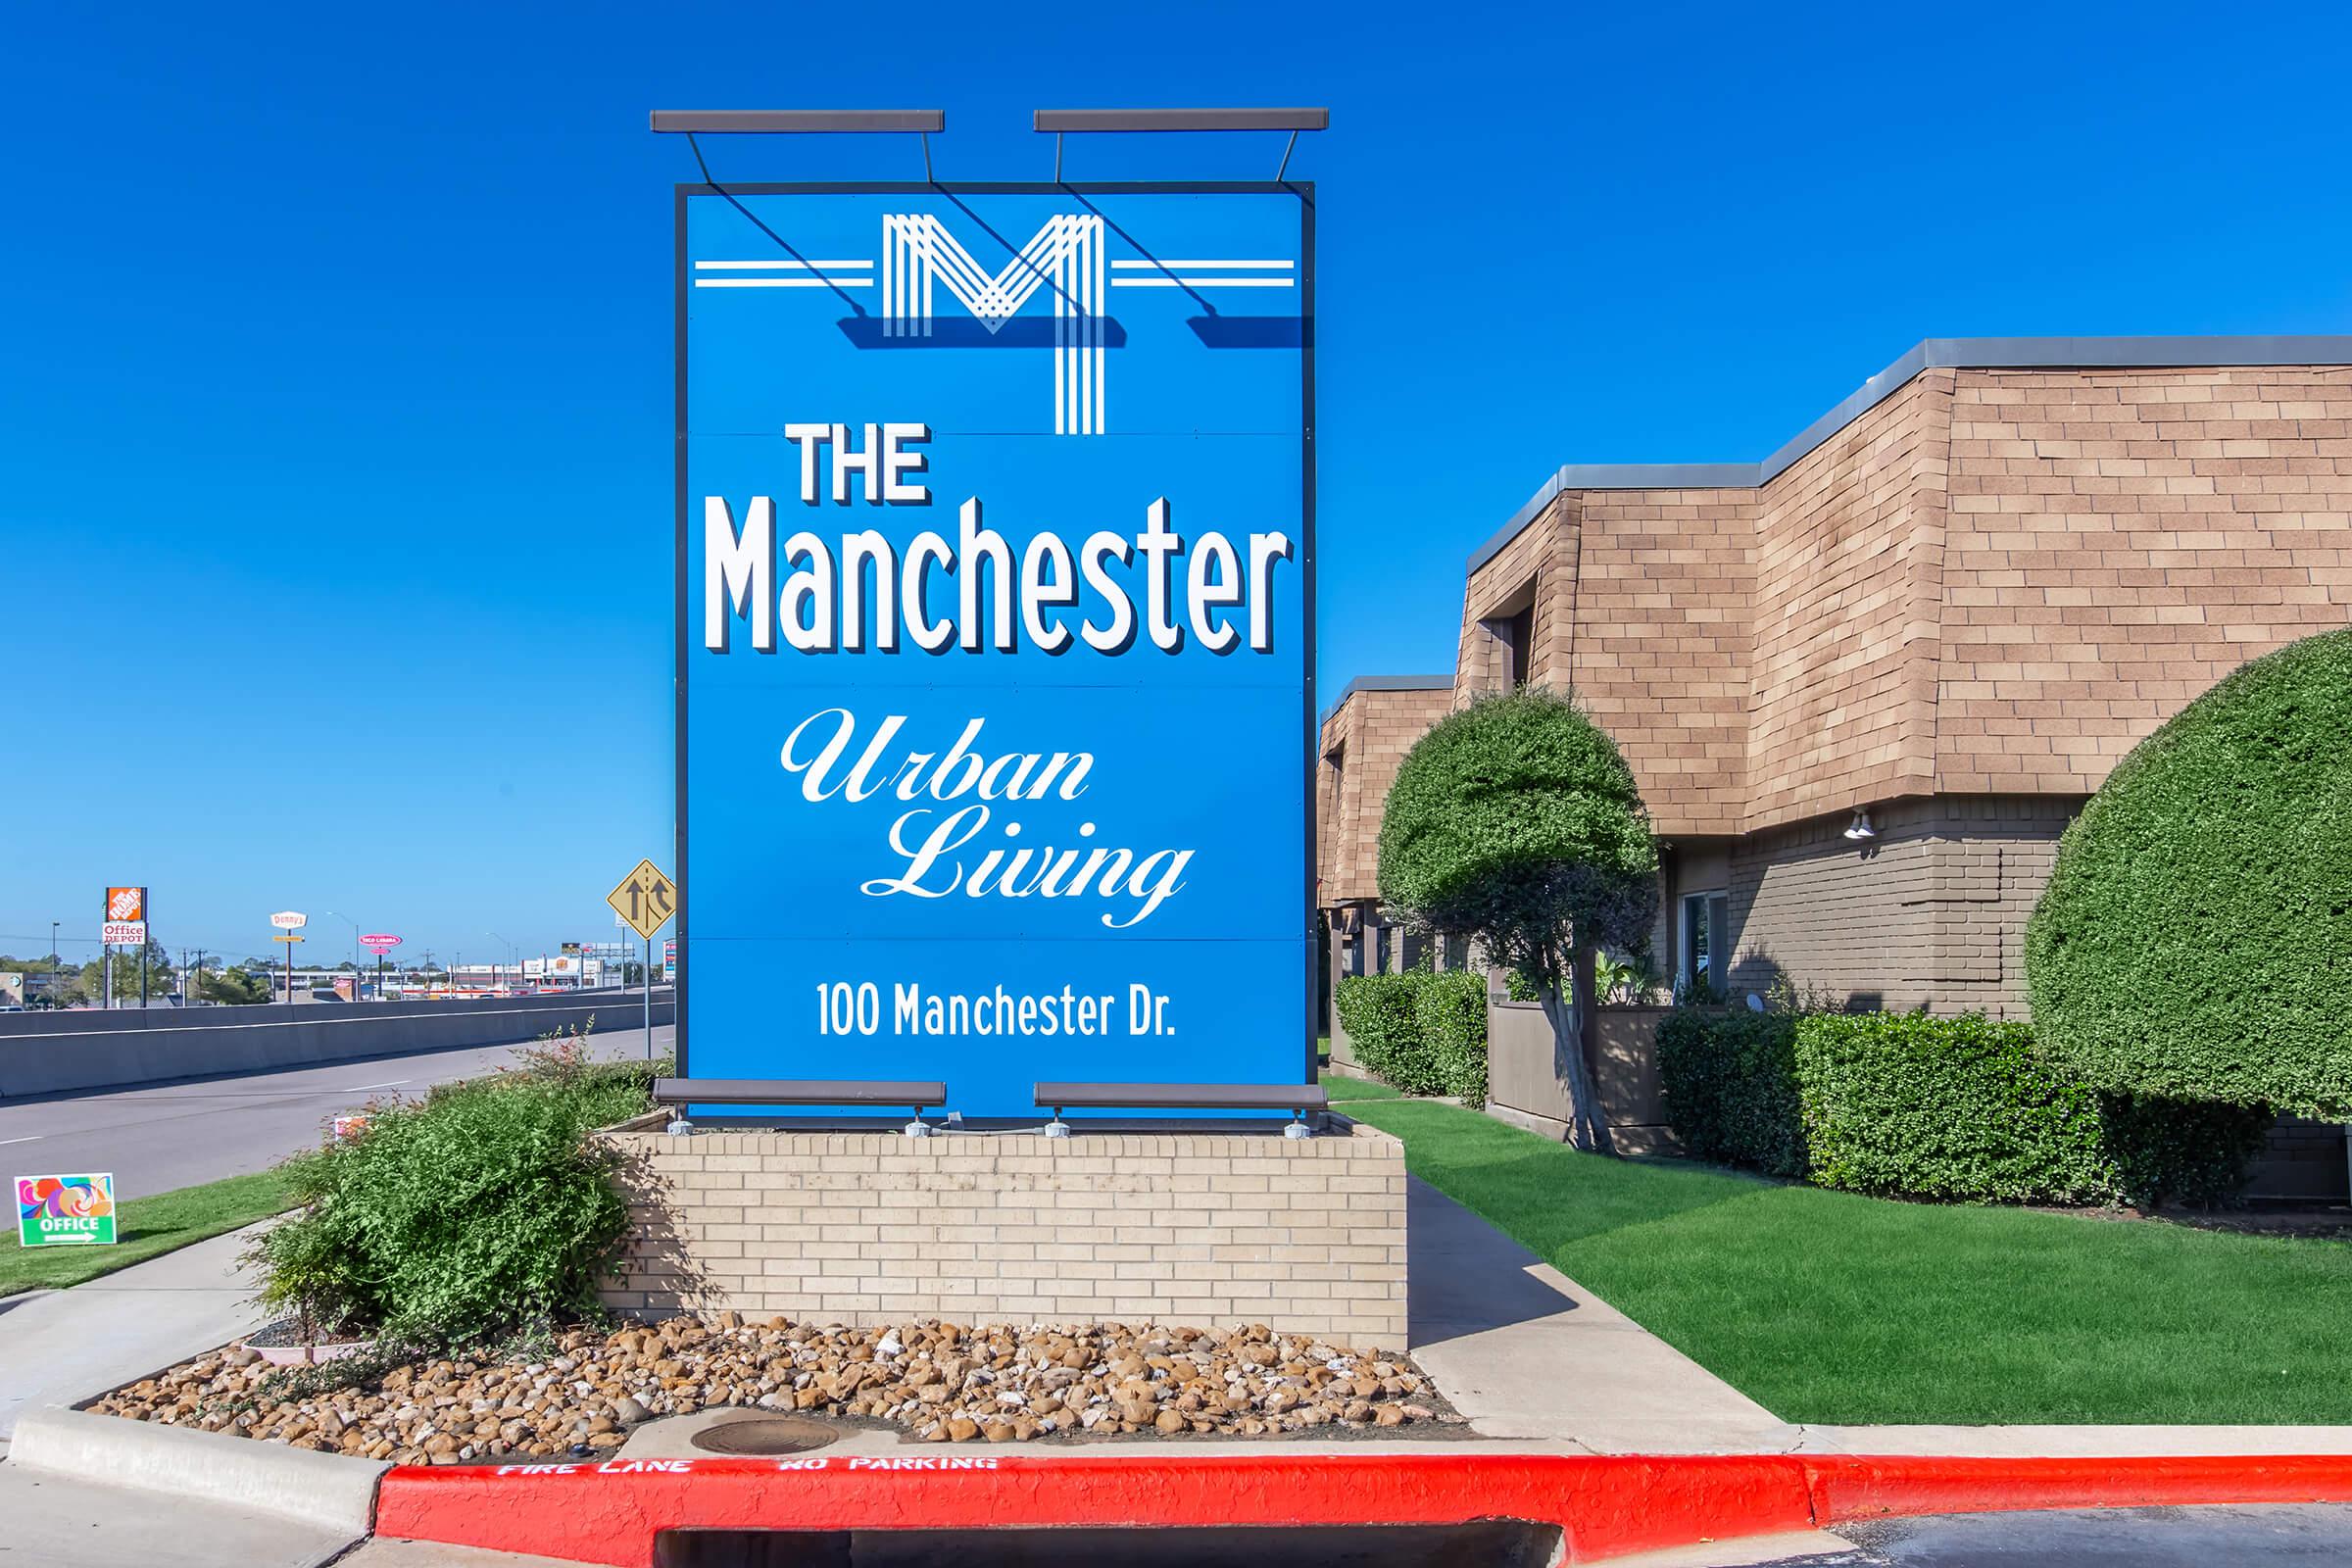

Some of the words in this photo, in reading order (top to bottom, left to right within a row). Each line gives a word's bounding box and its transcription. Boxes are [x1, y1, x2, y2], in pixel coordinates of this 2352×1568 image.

[785, 423, 931, 506] THE
[706, 495, 1295, 657] Manchester
[780, 708, 1095, 802] Urban
[860, 804, 1196, 929] Living
[105, 925, 143, 935] Office
[110, 888, 141, 919] HOME
[816, 982, 879, 1036] 100
[895, 982, 1115, 1036] Manchester
[1129, 982, 1176, 1036] Dr.
[40, 1217, 99, 1232] OFFICE
[497, 1463, 578, 1476] FIRE
[598, 1460, 695, 1473] LANE
[779, 1458, 827, 1470] NO
[849, 1457, 1000, 1471] PARKING
